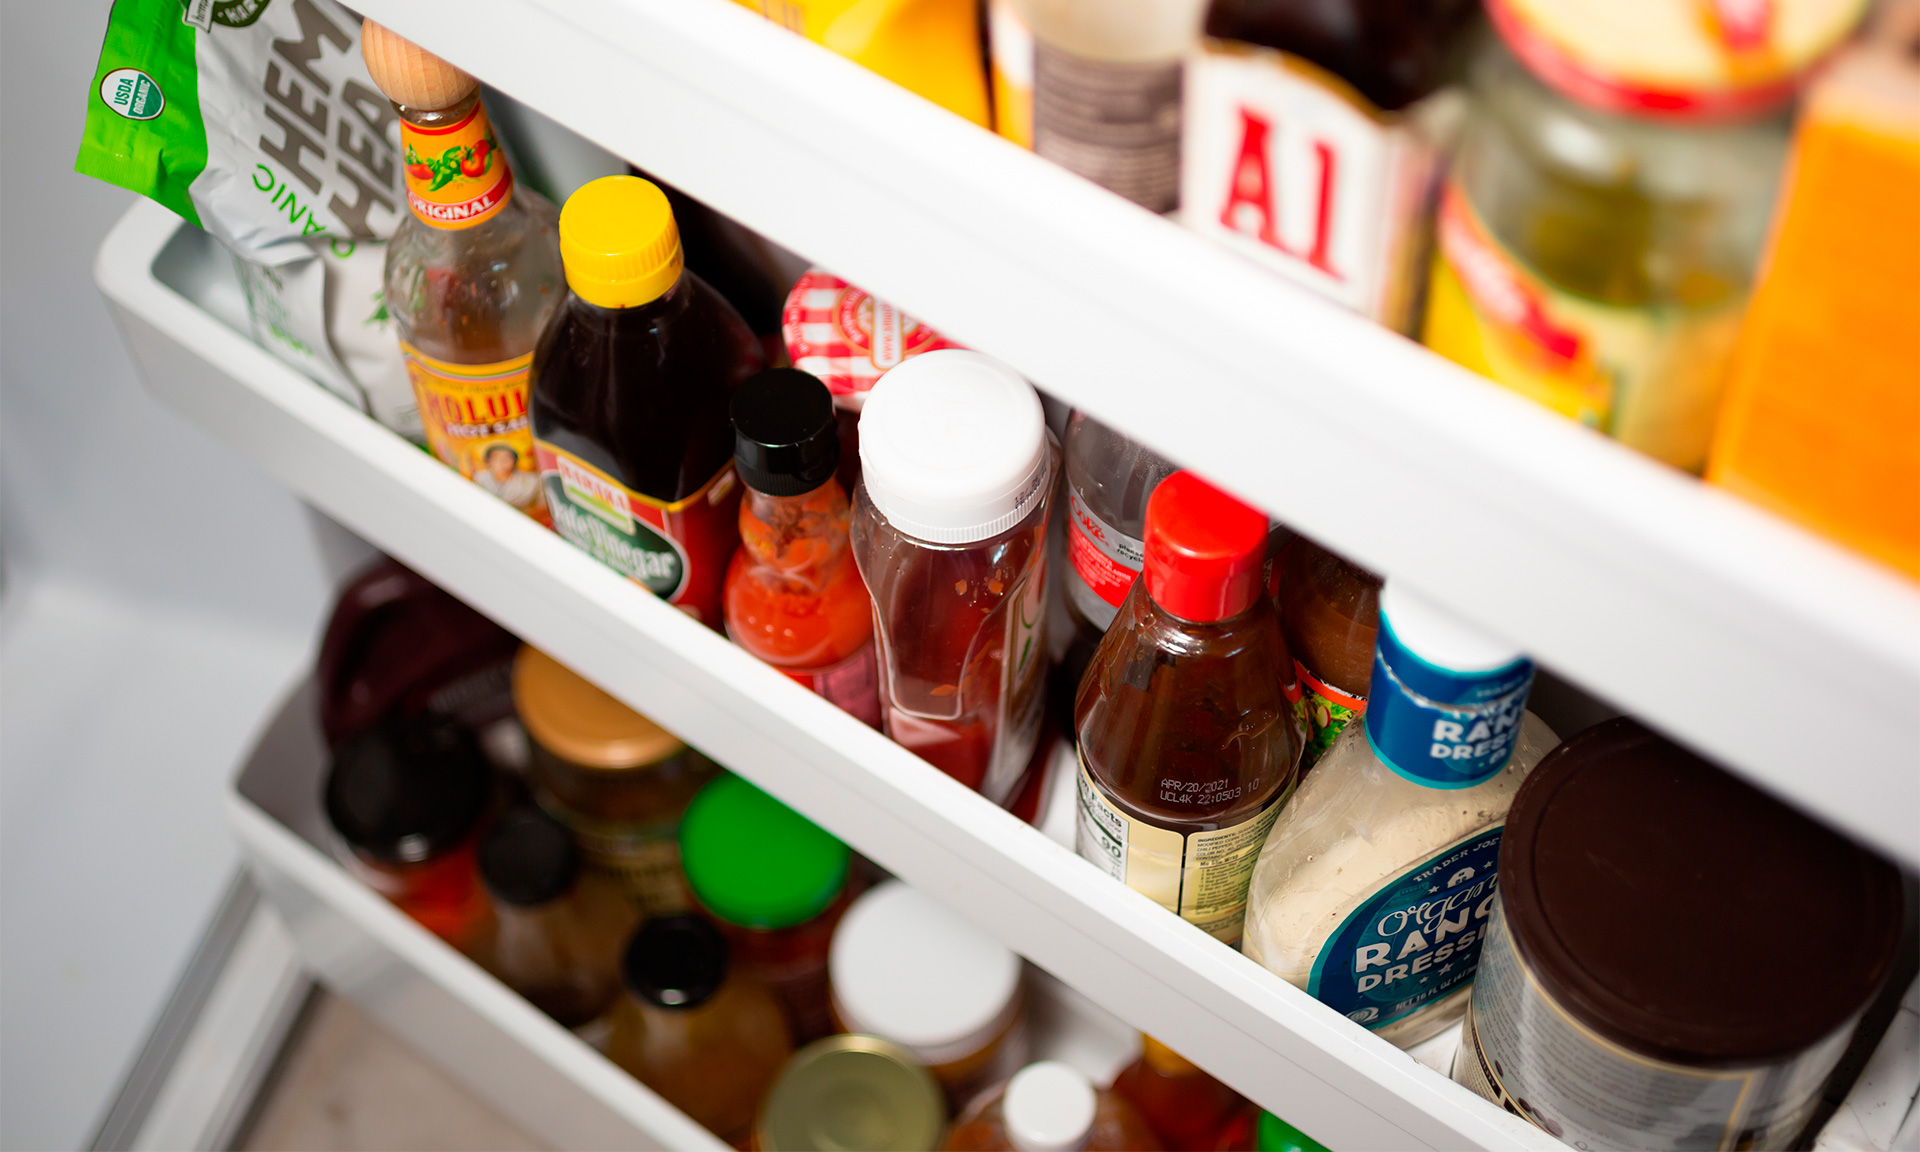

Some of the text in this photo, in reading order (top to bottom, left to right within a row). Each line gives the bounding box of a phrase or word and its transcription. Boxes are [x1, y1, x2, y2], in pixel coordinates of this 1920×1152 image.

[113, 78, 134, 106] USDA
[132, 79, 151, 115] ORGANIC
[1433, 705, 1520, 743] RAN
[1159, 778, 1260, 805] UCL4K 22:0503 10
[1161, 778, 1229, 794] APR/20/2021
[1101, 836, 1122, 858] 90
[1412, 837, 1502, 883] TRADER JOE
